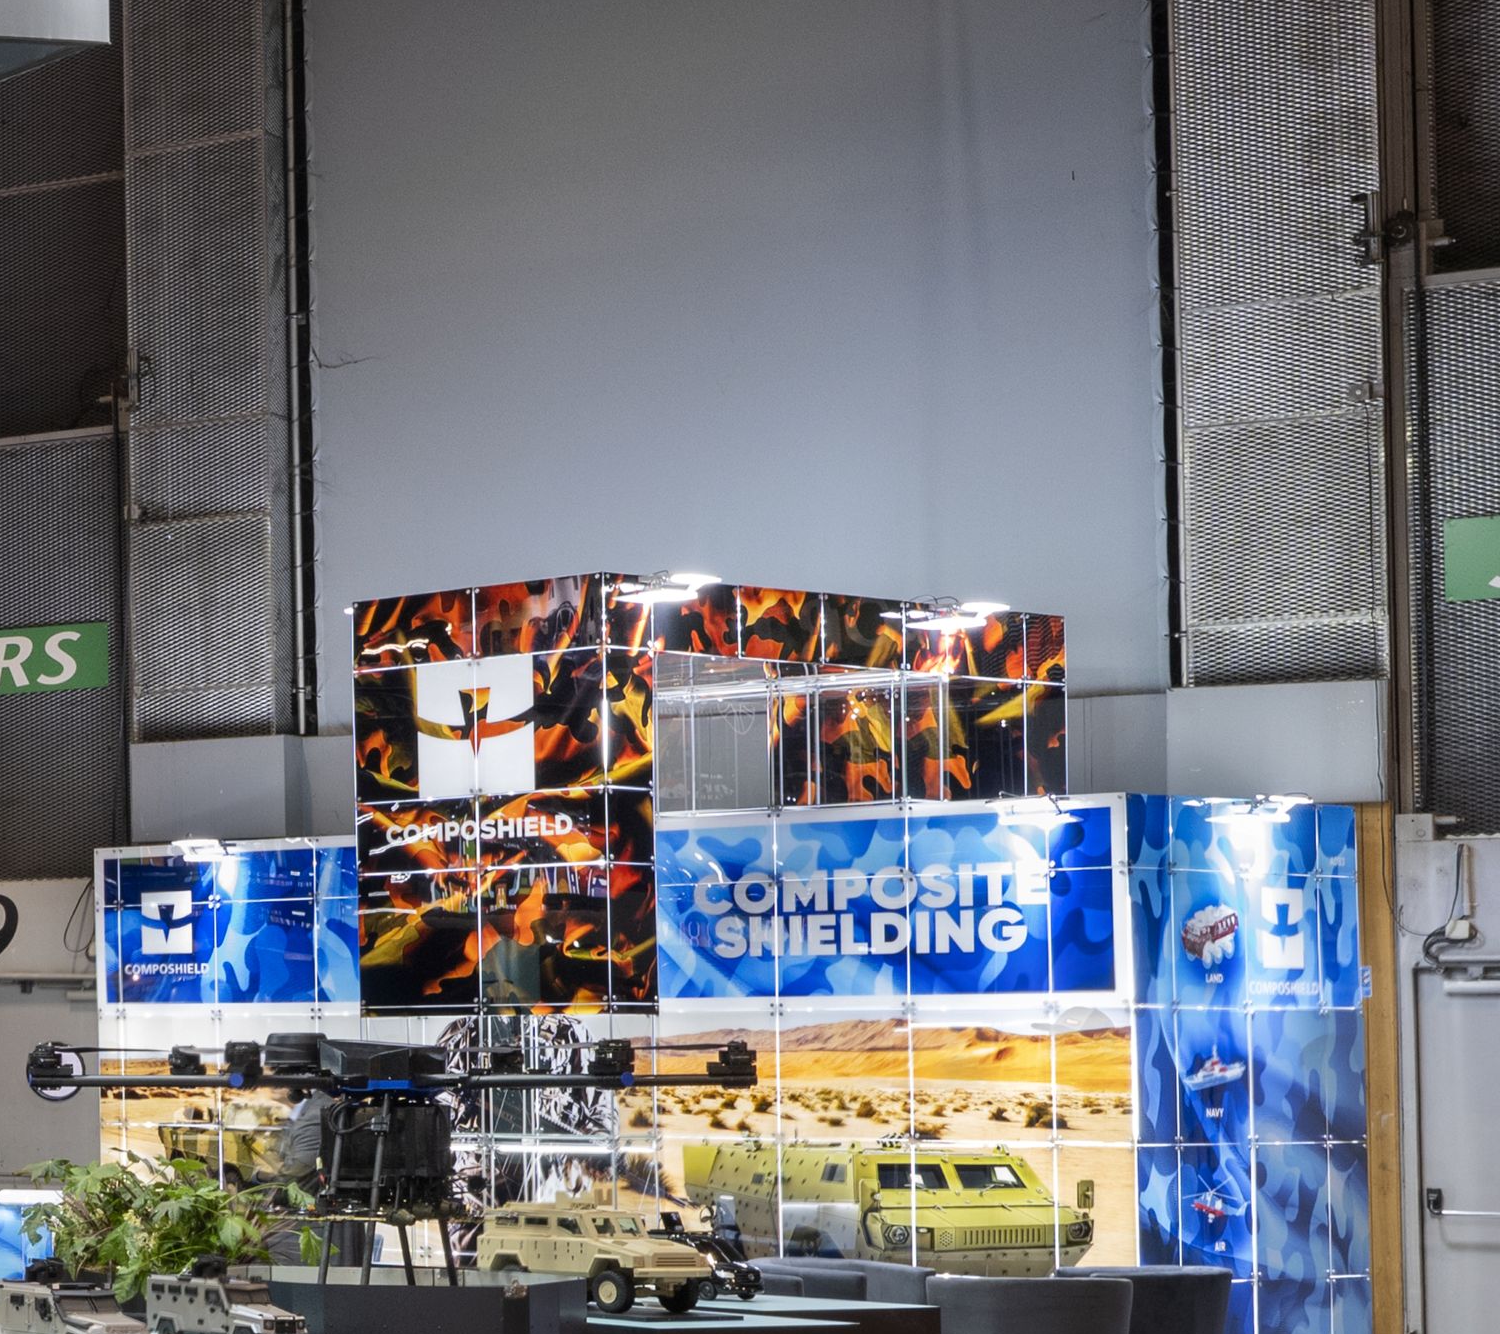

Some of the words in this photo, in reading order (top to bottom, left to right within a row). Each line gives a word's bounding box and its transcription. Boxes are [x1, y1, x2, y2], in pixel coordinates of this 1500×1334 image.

[386, 813, 574, 844] COMPOSHIELD
[693, 858, 1051, 916] COMPOSITE
[714, 907, 1029, 959] SHIELDING
[124, 962, 210, 975] COMPOSHIELD
[1205, 973, 1224, 984] LAND
[1206, 1107, 1225, 1118] NAVY
[1214, 1241, 1226, 1252] AIR
